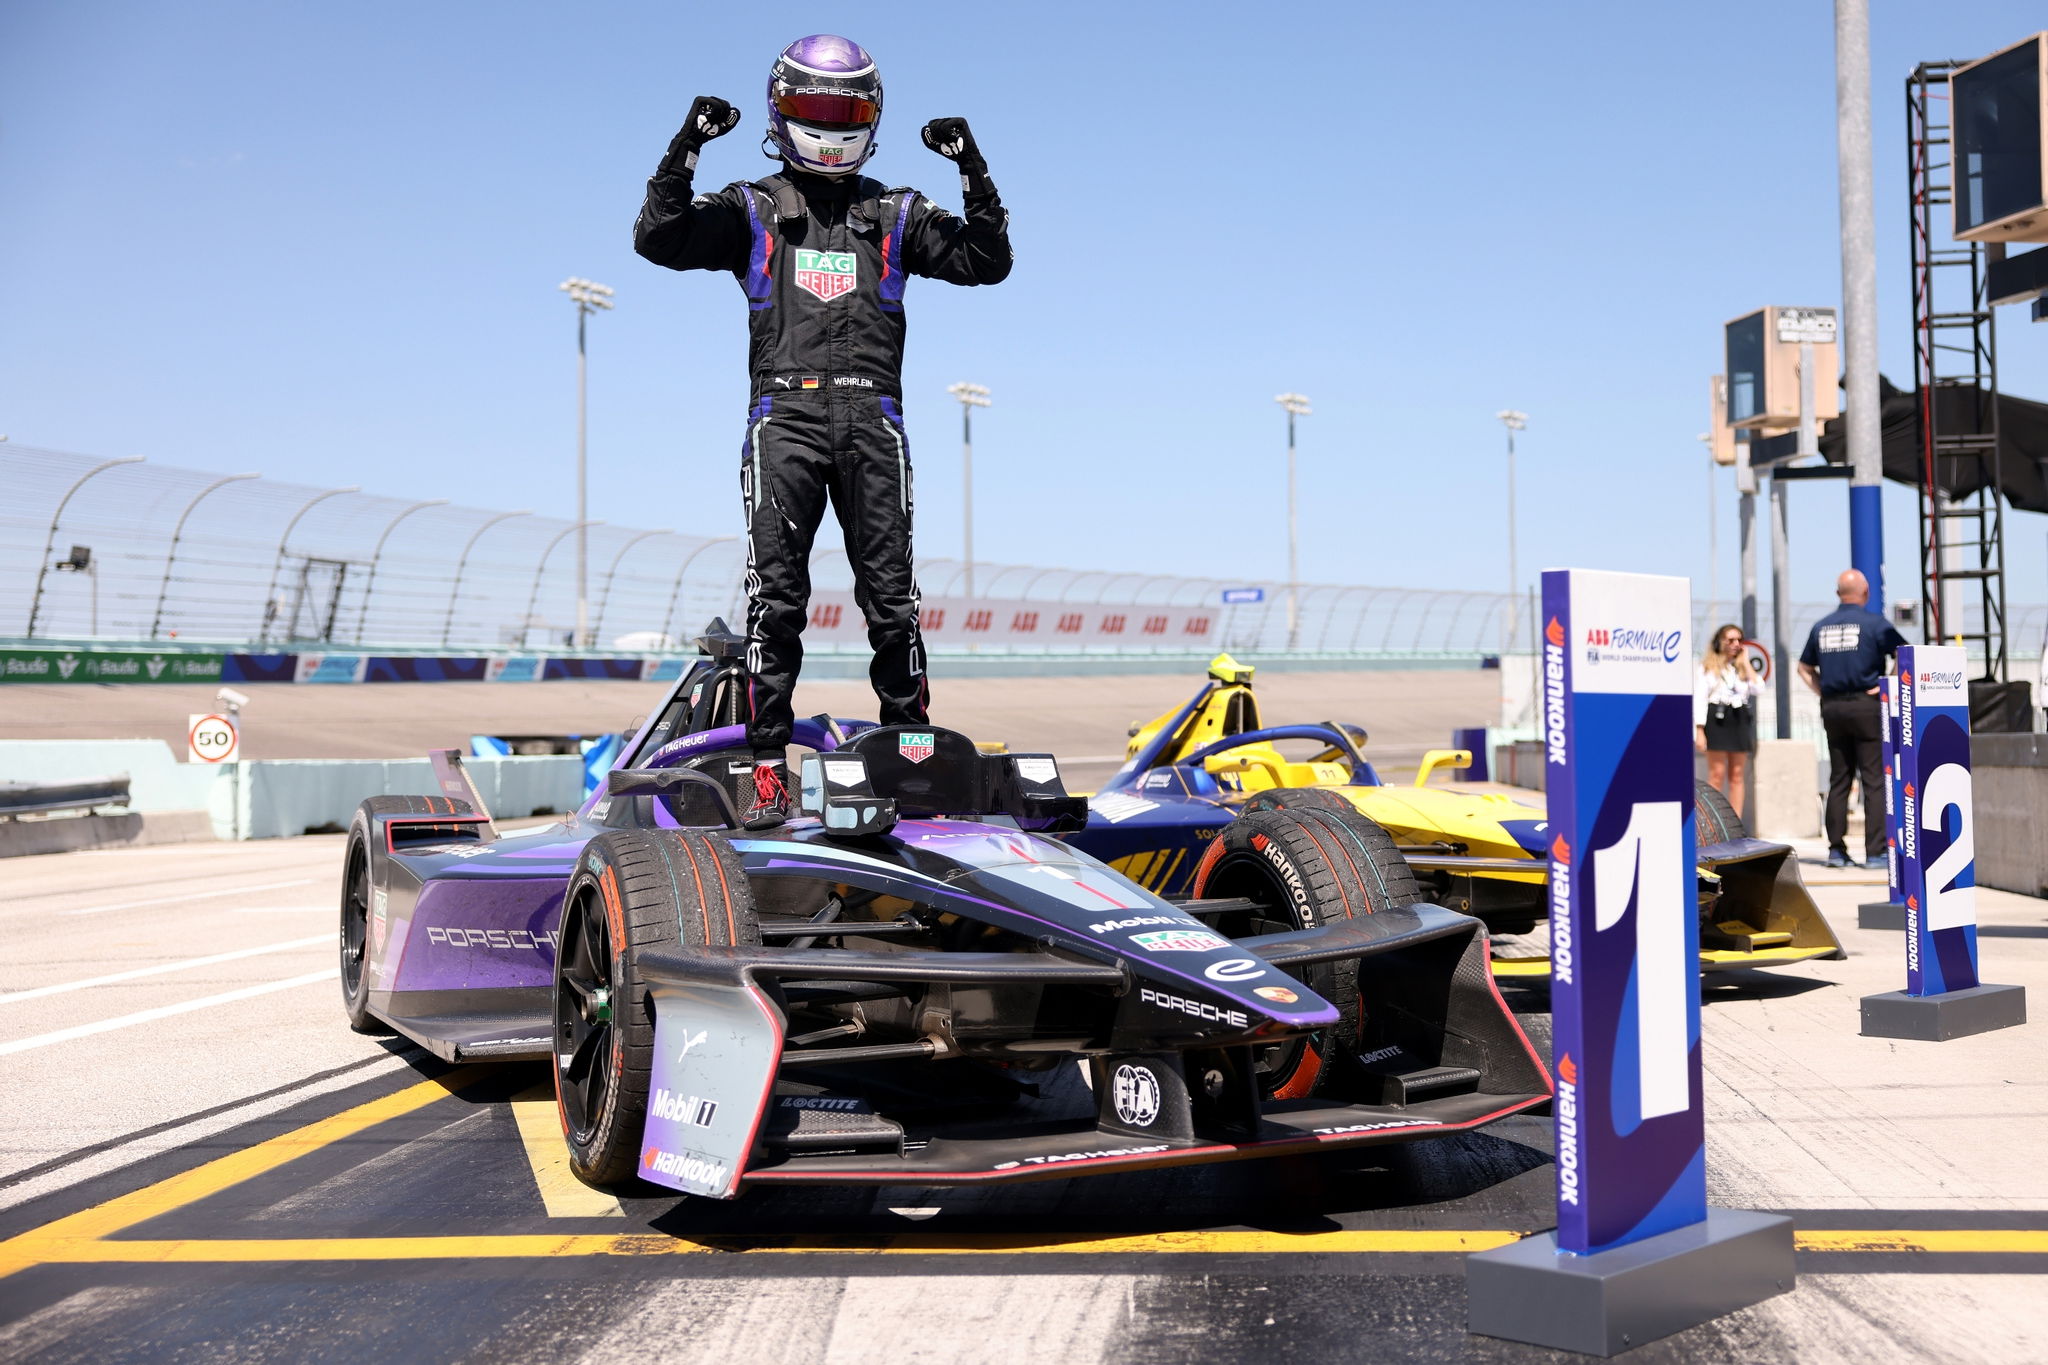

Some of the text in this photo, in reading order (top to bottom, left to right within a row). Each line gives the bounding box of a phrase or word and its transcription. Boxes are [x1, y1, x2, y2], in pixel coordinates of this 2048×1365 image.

[795, 87, 869, 100] PORSCHE
[801, 253, 850, 272] TAG
[800, 273, 852, 298] HEUER
[834, 377, 873, 388] WEHRLEIN
[1587, 629, 1609, 646] ABB
[199, 731, 228, 746] 50
[902, 735, 931, 745] TAG
[901, 746, 932, 761] HEUER
[1922, 763, 1976, 932] 2
[1088, 916, 1176, 934] Mobil
[1594, 801, 1689, 1120] 1
[1140, 988, 1248, 1029] PORSCHE
[1360, 1045, 1402, 1064] LOCTITE
[651, 1088, 699, 1125] Mobil
[780, 1097, 859, 1109] LOCTITE
